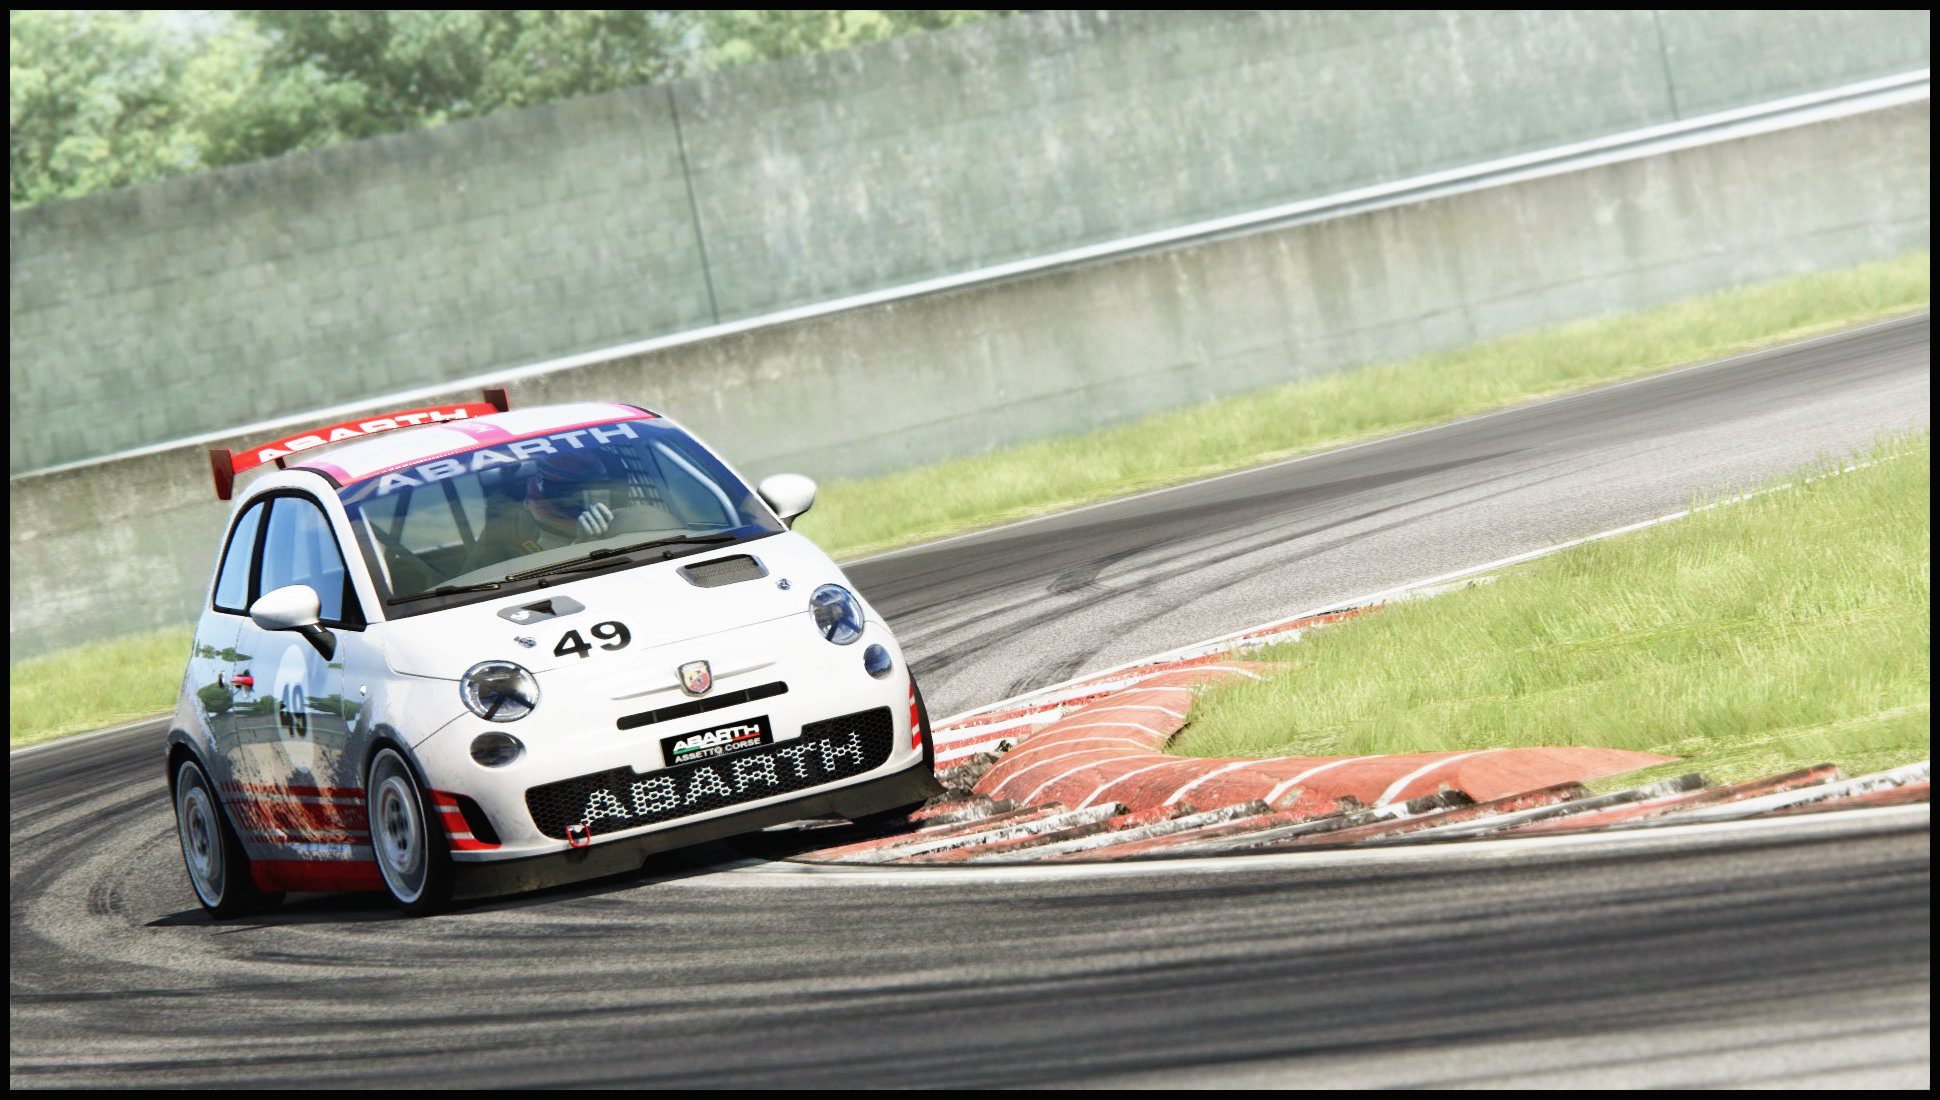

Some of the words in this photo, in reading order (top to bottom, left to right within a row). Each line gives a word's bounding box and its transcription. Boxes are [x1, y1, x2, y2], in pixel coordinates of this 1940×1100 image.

[377, 423, 639, 496] ABARTH
[553, 620, 632, 659] 49
[279, 683, 308, 738] 49
[673, 724, 760, 752] ABARTH
[674, 746, 723, 763] ASSETTO
[724, 737, 762, 752] CORSE
[580, 732, 864, 826] ABARTH
